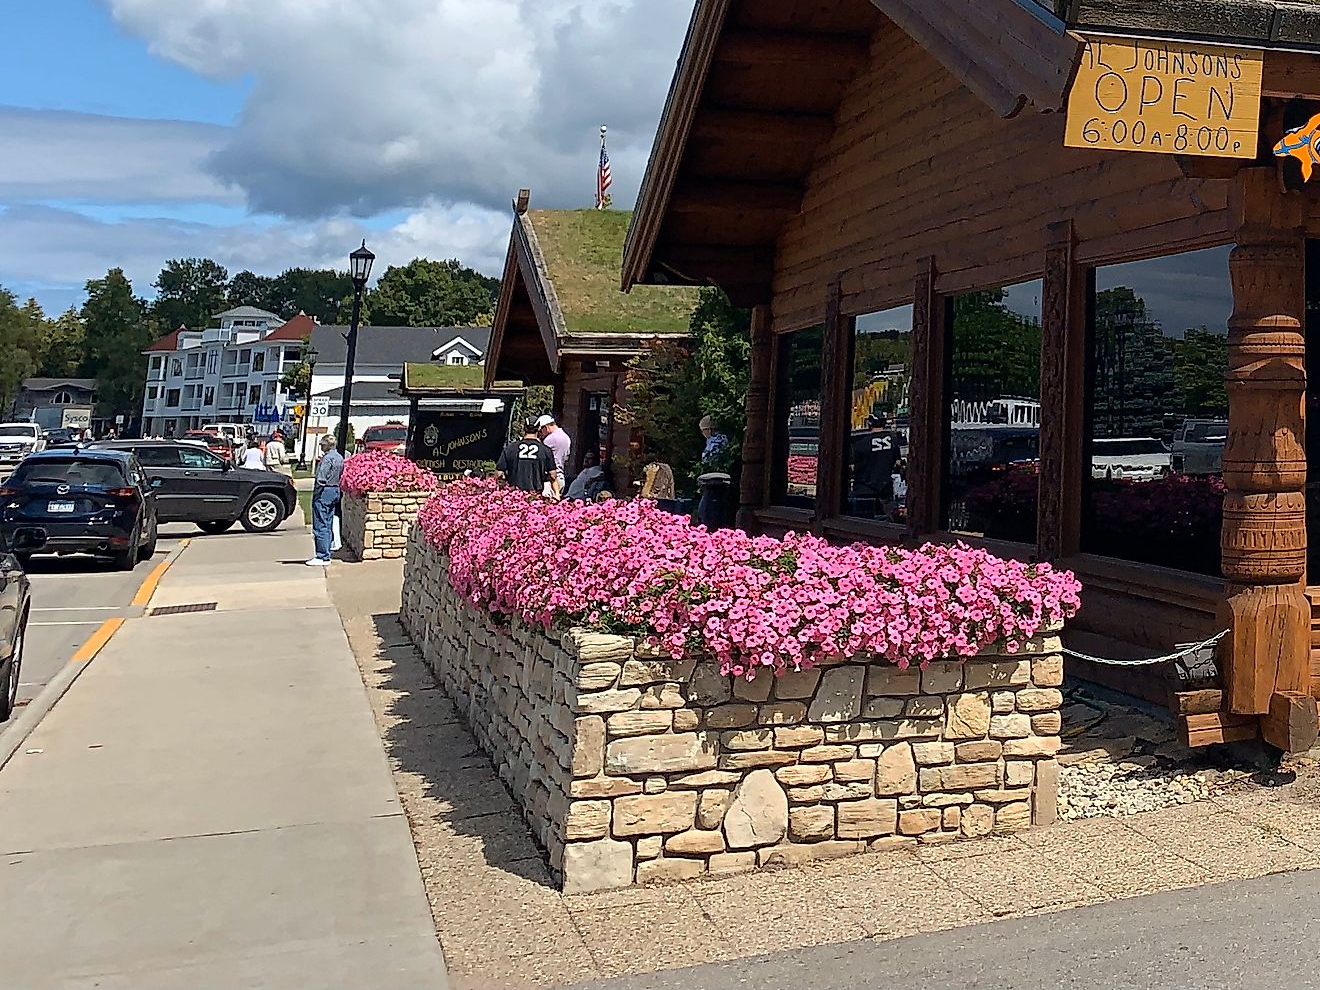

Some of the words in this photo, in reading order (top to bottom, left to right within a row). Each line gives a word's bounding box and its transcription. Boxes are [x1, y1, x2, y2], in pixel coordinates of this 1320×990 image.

[1123, 40, 1243, 80] JOHNSONS
[1095, 72, 1236, 122] OPEN
[65, 414, 88, 423] Sysco
[312, 406, 327, 415] 30
[519, 443, 538, 459] 22
